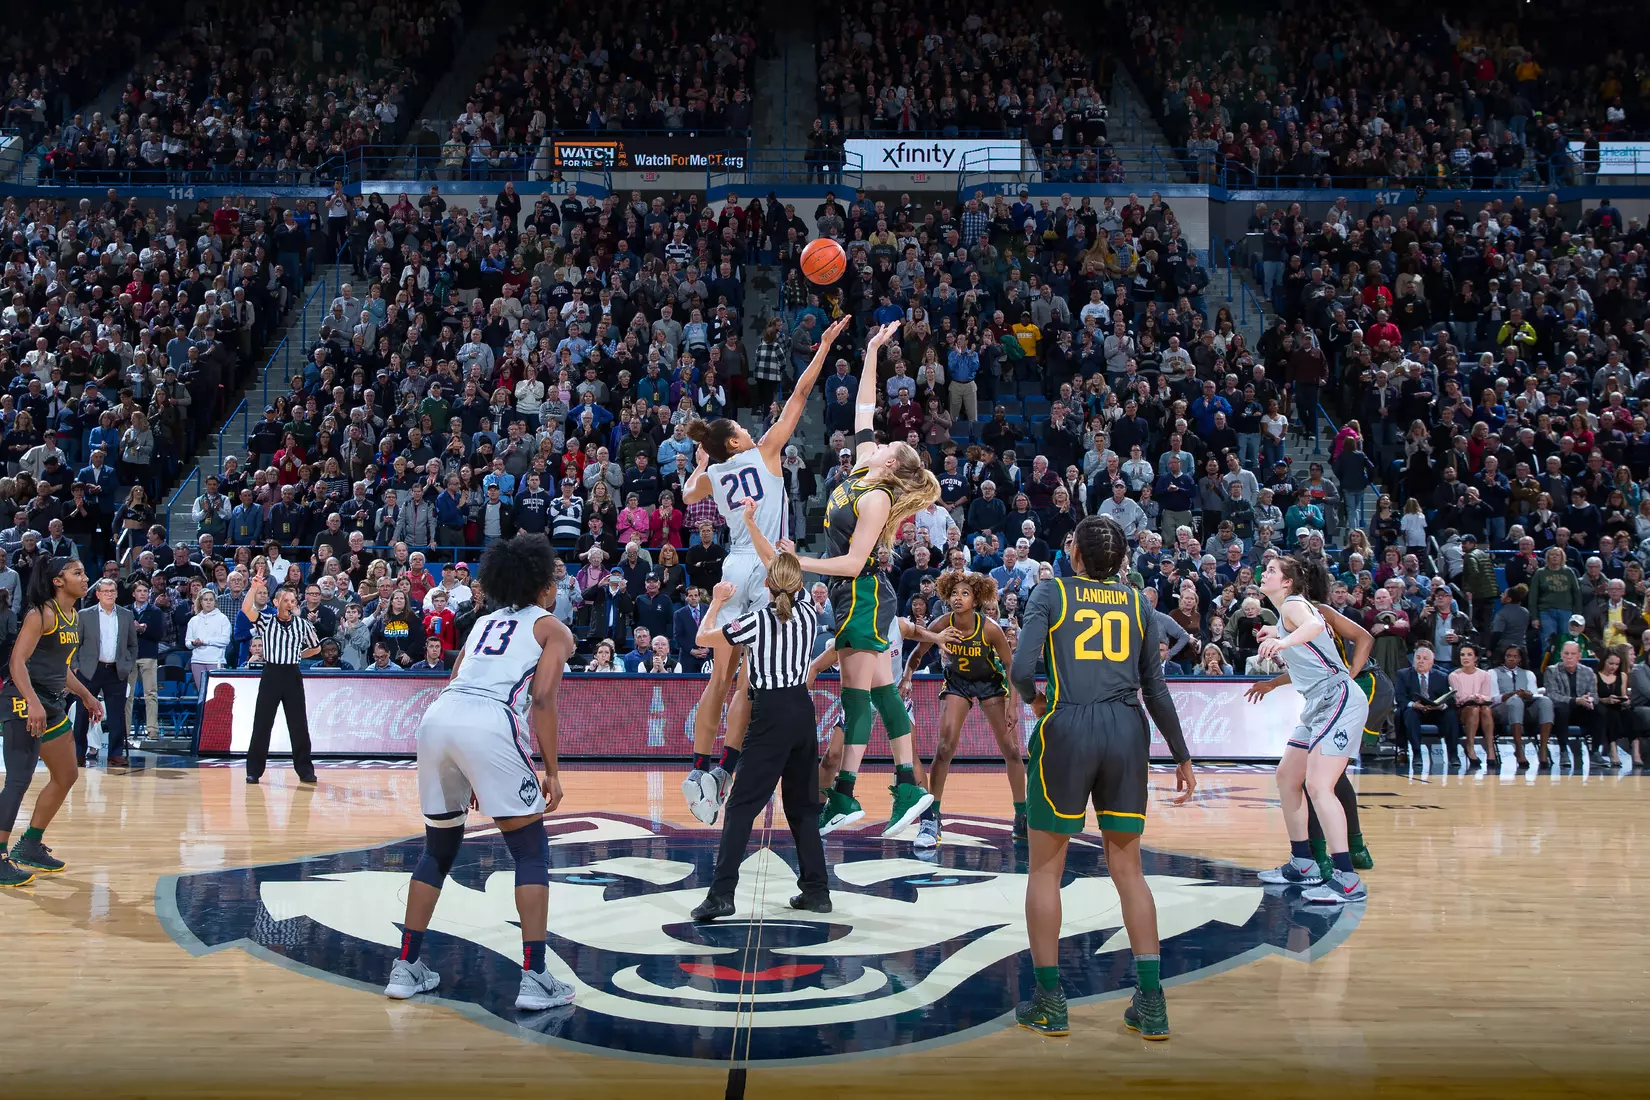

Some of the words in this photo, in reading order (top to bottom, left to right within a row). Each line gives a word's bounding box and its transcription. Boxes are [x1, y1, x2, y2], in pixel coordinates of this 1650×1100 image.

[560, 147, 614, 159] WATCH
[882, 142, 956, 168] xfinity
[168, 187, 195, 200] 114
[720, 467, 765, 511] 20
[940, 478, 963, 488] UCONN
[1075, 586, 1129, 605] LANDRUM
[59, 631, 79, 644] BAYL
[472, 619, 519, 656] 13
[1073, 608, 1131, 662] 20
[957, 657, 971, 672] 2
